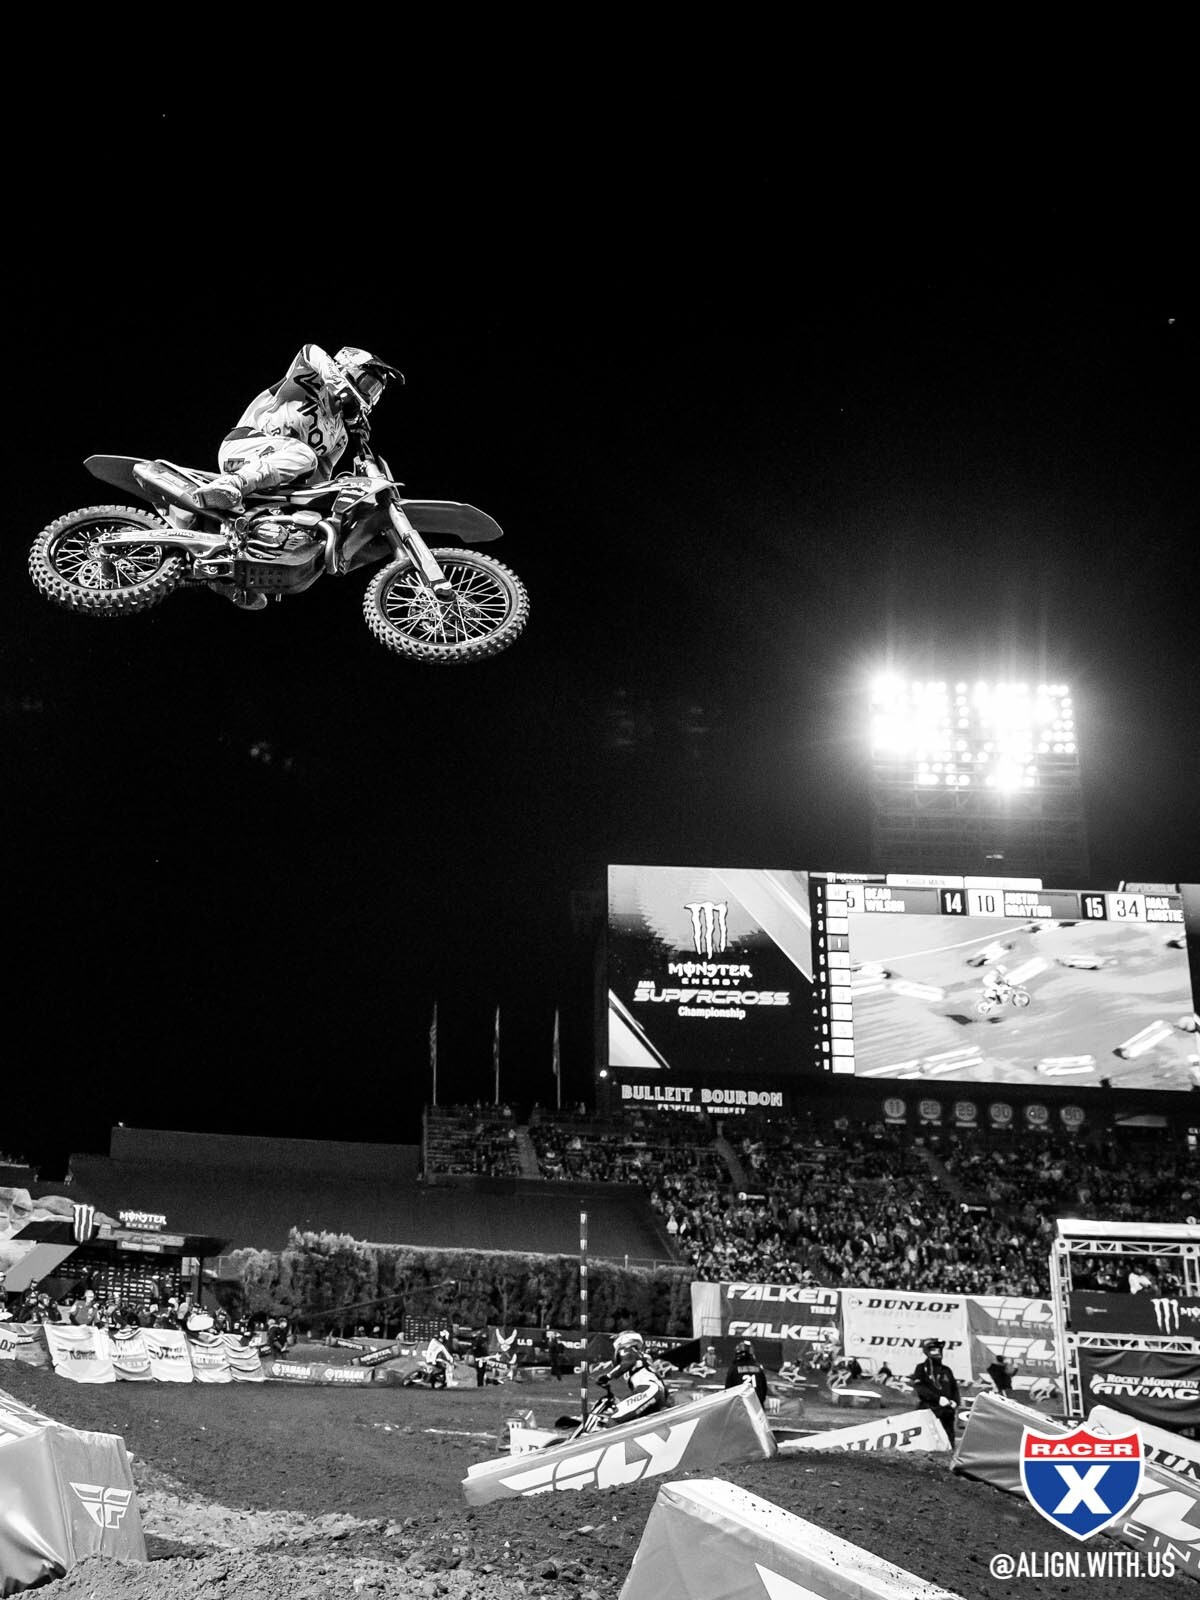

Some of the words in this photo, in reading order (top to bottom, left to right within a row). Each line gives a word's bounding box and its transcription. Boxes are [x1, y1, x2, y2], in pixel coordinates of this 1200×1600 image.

[944, 892, 962, 913] 14
[977, 895, 995, 913] 10
[1085, 897, 1104, 918] 15
[1116, 899, 1139, 918] 34
[668, 961, 753, 978] MONSTER
[634, 988, 791, 1006] SUPERCROSS
[678, 1006, 746, 1020] Championship
[621, 1085, 693, 1102] BULLEIT
[701, 1088, 783, 1107] BOURBON
[119, 1209, 167, 1225] MONSTER
[727, 1284, 839, 1305] FALKEN
[867, 1298, 960, 1313] DUNLOP
[997, 1319, 1054, 1329] RACIN
[869, 1336, 963, 1350] DUNP
[1106, 1374, 1140, 1385] ROCKY
[1141, 1376, 1199, 1389] MOUNTAIN
